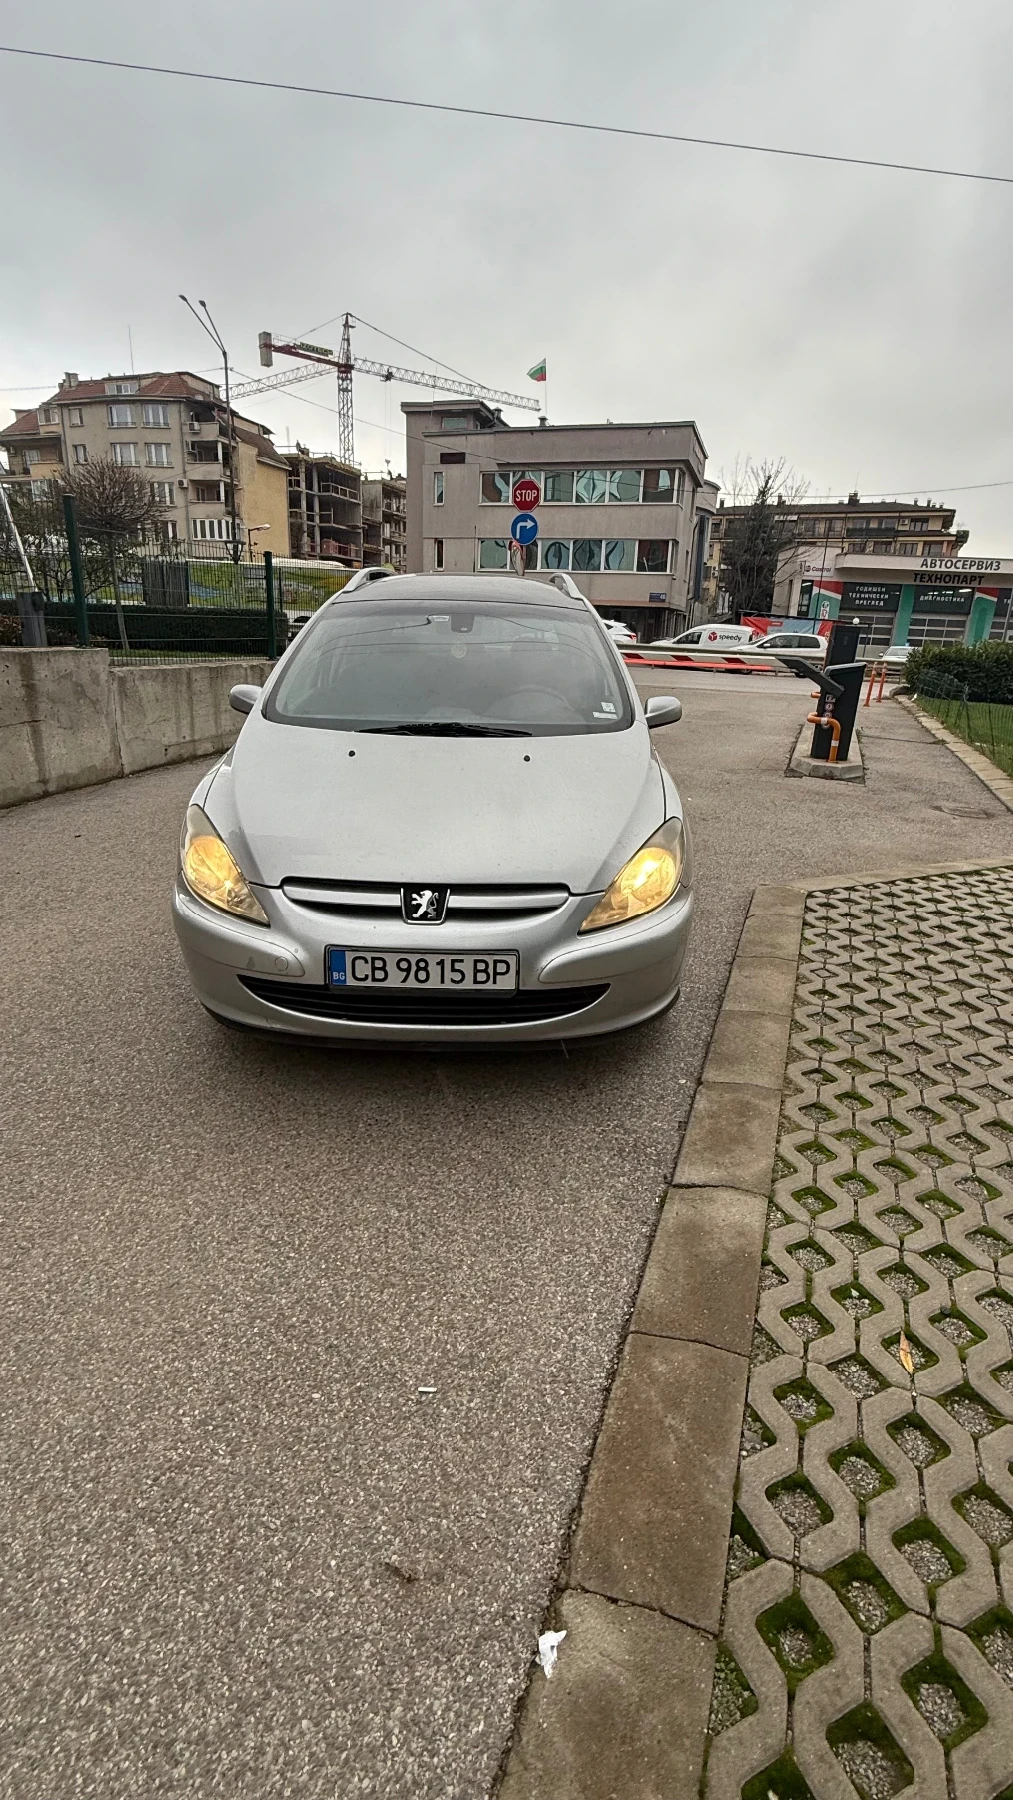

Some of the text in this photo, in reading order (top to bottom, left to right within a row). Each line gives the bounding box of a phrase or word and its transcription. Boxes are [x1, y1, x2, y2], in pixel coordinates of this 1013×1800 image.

[515, 489, 538, 502] STOP
[920, 558, 1002, 571] АВТОСЕРВИЗ
[913, 572, 985, 586] ТЕХНОПАРТ
[849, 592, 889, 600] ТЕХНИЧЕСКИ
[919, 595, 965, 603] ДИАГНОСТИКА
[718, 633, 742, 642] speedy
[333, 971, 345, 981] BG
[351, 956, 511, 985] CB 9815 BP
